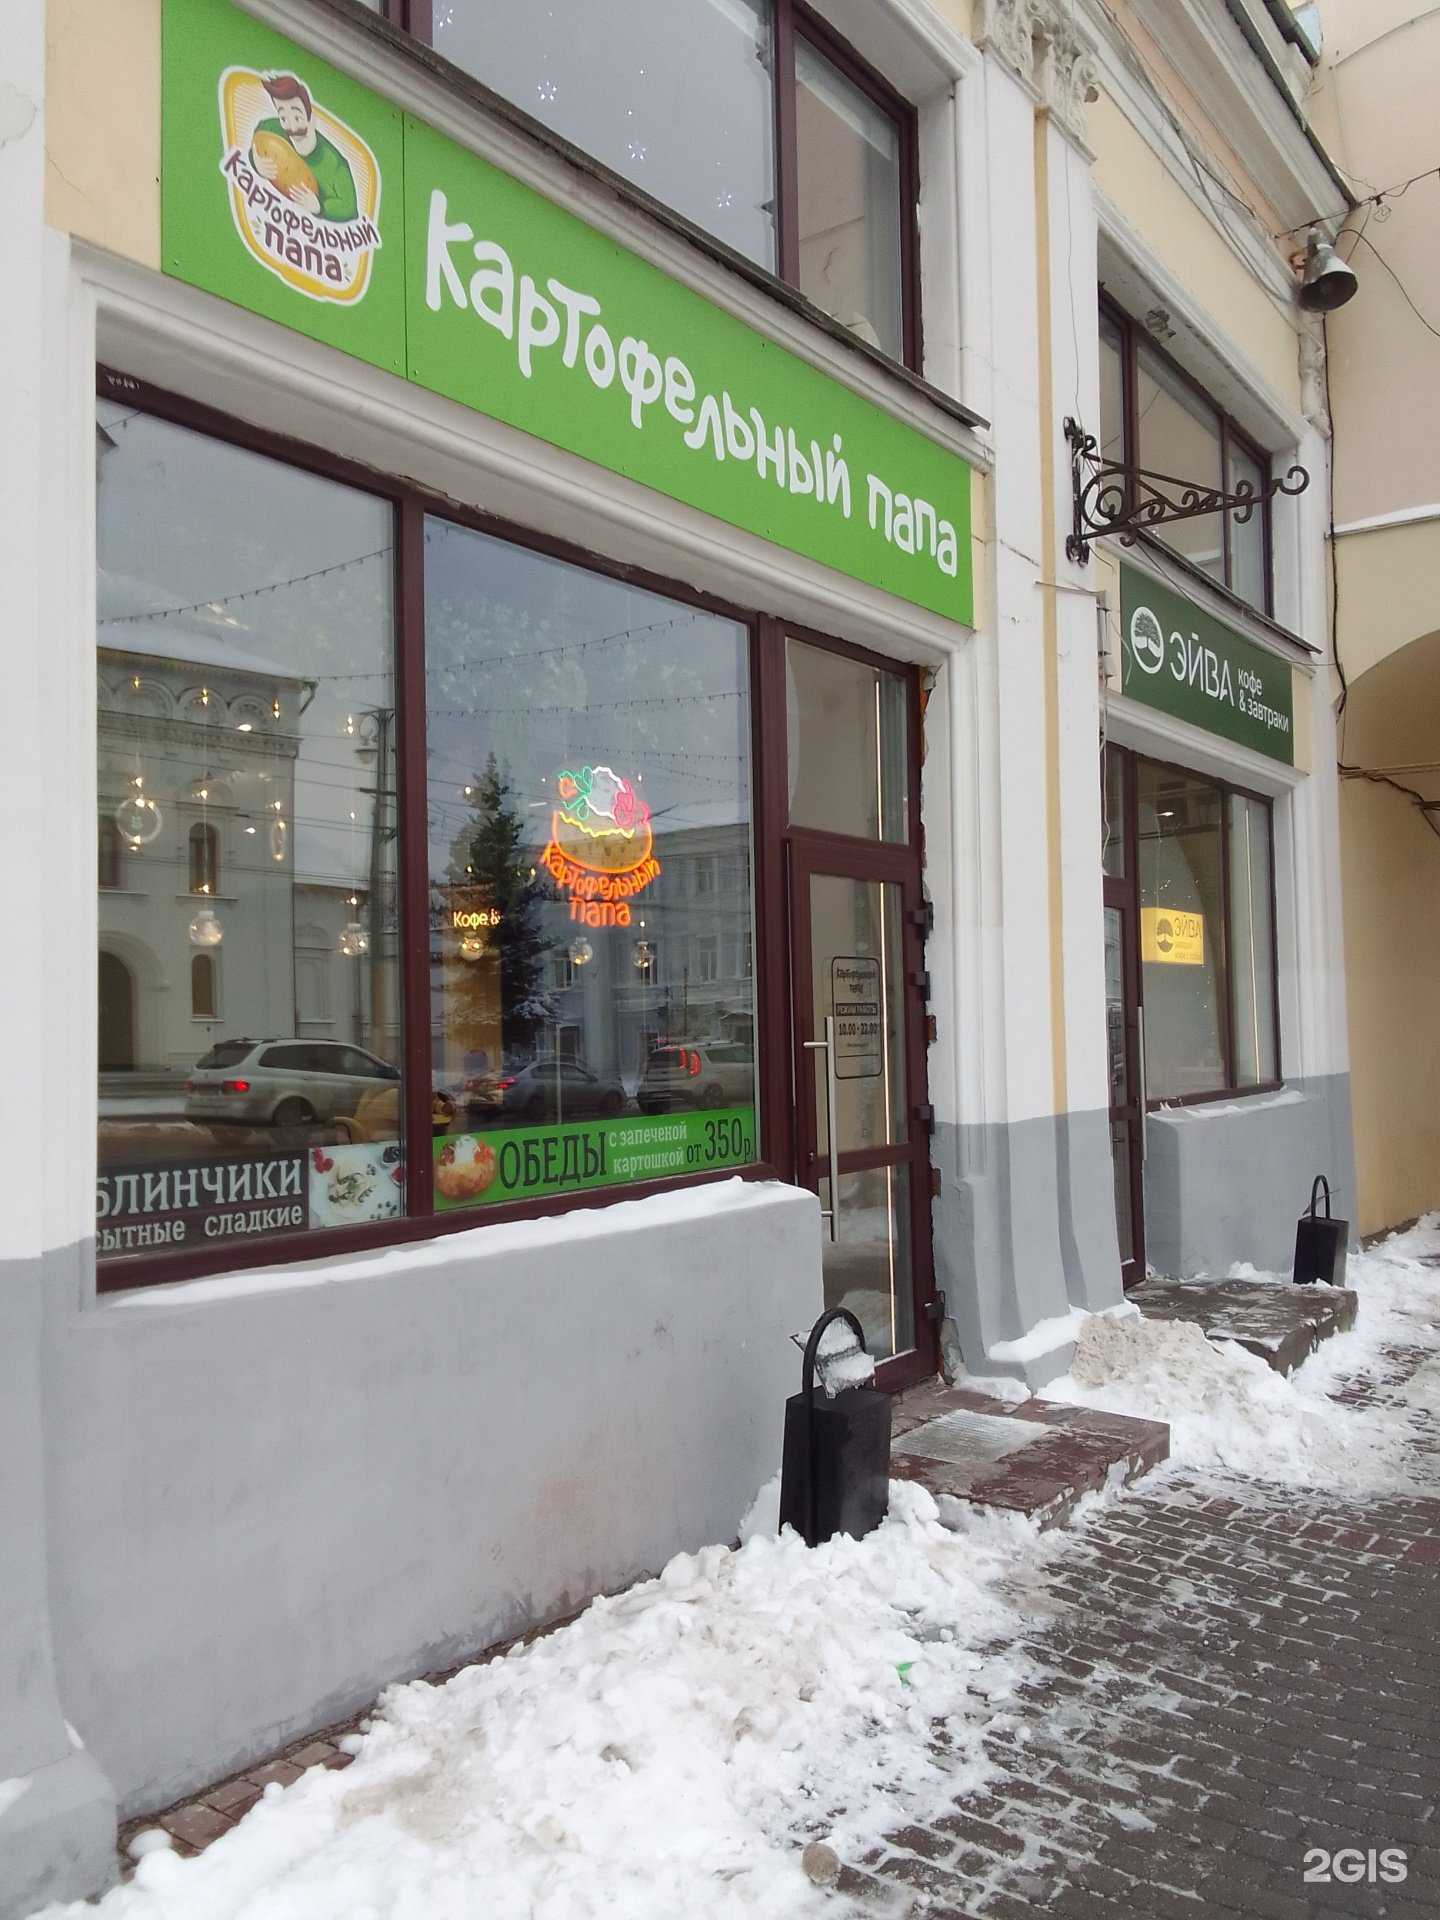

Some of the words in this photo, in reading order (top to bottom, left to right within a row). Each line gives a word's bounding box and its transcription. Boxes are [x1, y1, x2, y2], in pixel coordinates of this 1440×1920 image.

[224, 150, 379, 252] Картофельный
[264, 221, 343, 282] папа
[425, 189, 851, 518] Картофельный
[866, 473, 958, 578] папа
[1169, 631, 1235, 707] ЭЙВА
[1238, 668, 1263, 696] кофе
[1239, 689, 1247, 712] &
[1247, 698, 1289, 733] завтраки
[500, 1131, 607, 1189] ОБЕДЫ
[613, 1147, 685, 1178] картошкой
[687, 1143, 702, 1163] от
[204, 1205, 303, 1237] сладкие
